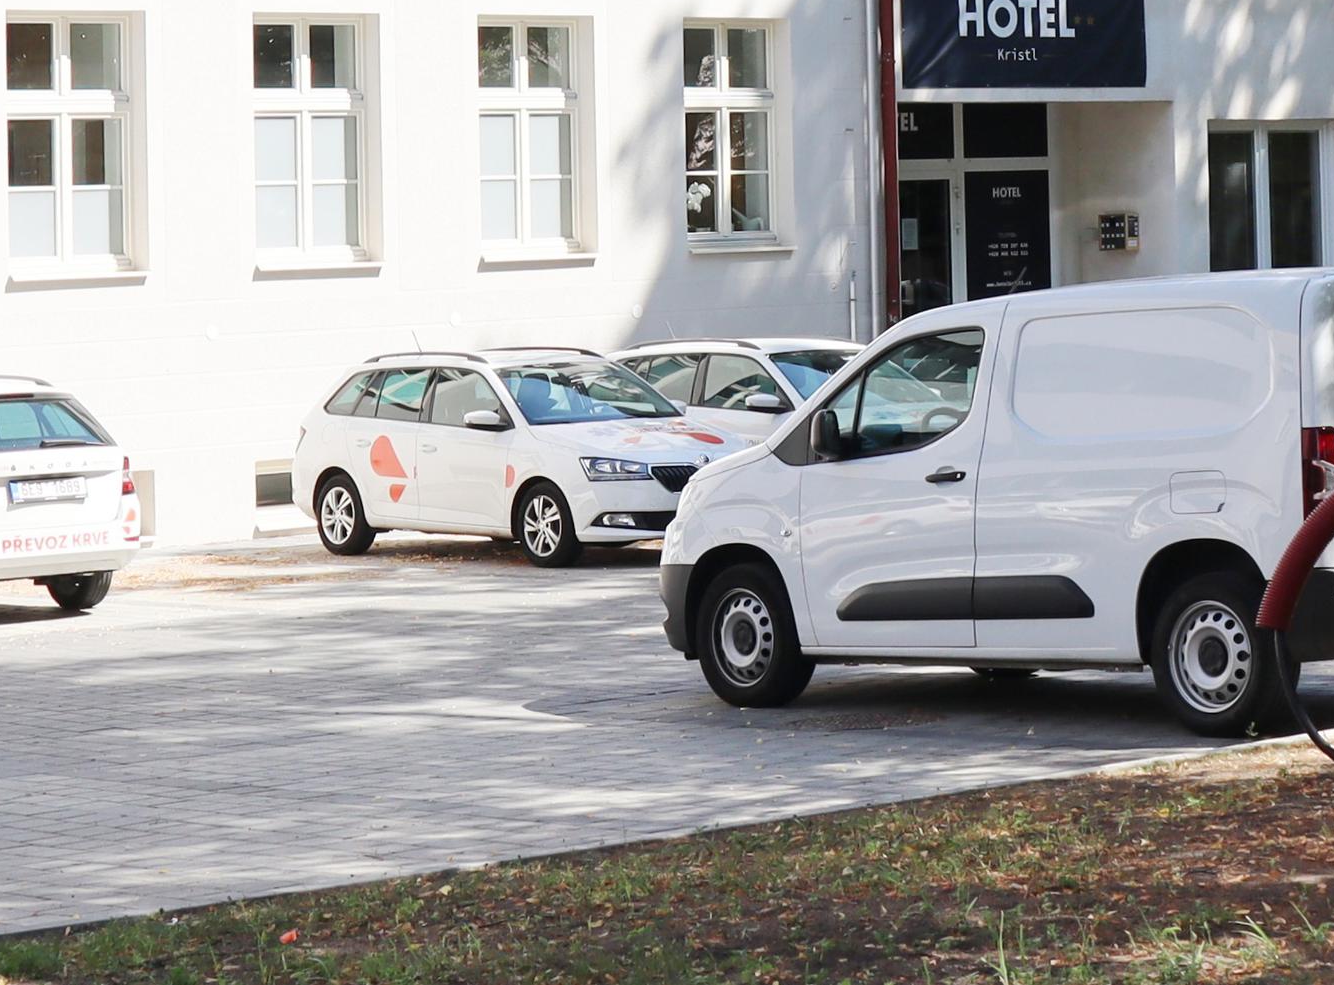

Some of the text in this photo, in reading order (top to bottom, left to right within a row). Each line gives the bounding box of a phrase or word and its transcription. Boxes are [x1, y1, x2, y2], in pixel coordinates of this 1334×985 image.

[997, 47, 1038, 62] Kristl
[899, 112, 919, 132] EL
[992, 186, 1022, 198] HOTEL
[2, 530, 110, 554] PŘEVOZ KRVE
